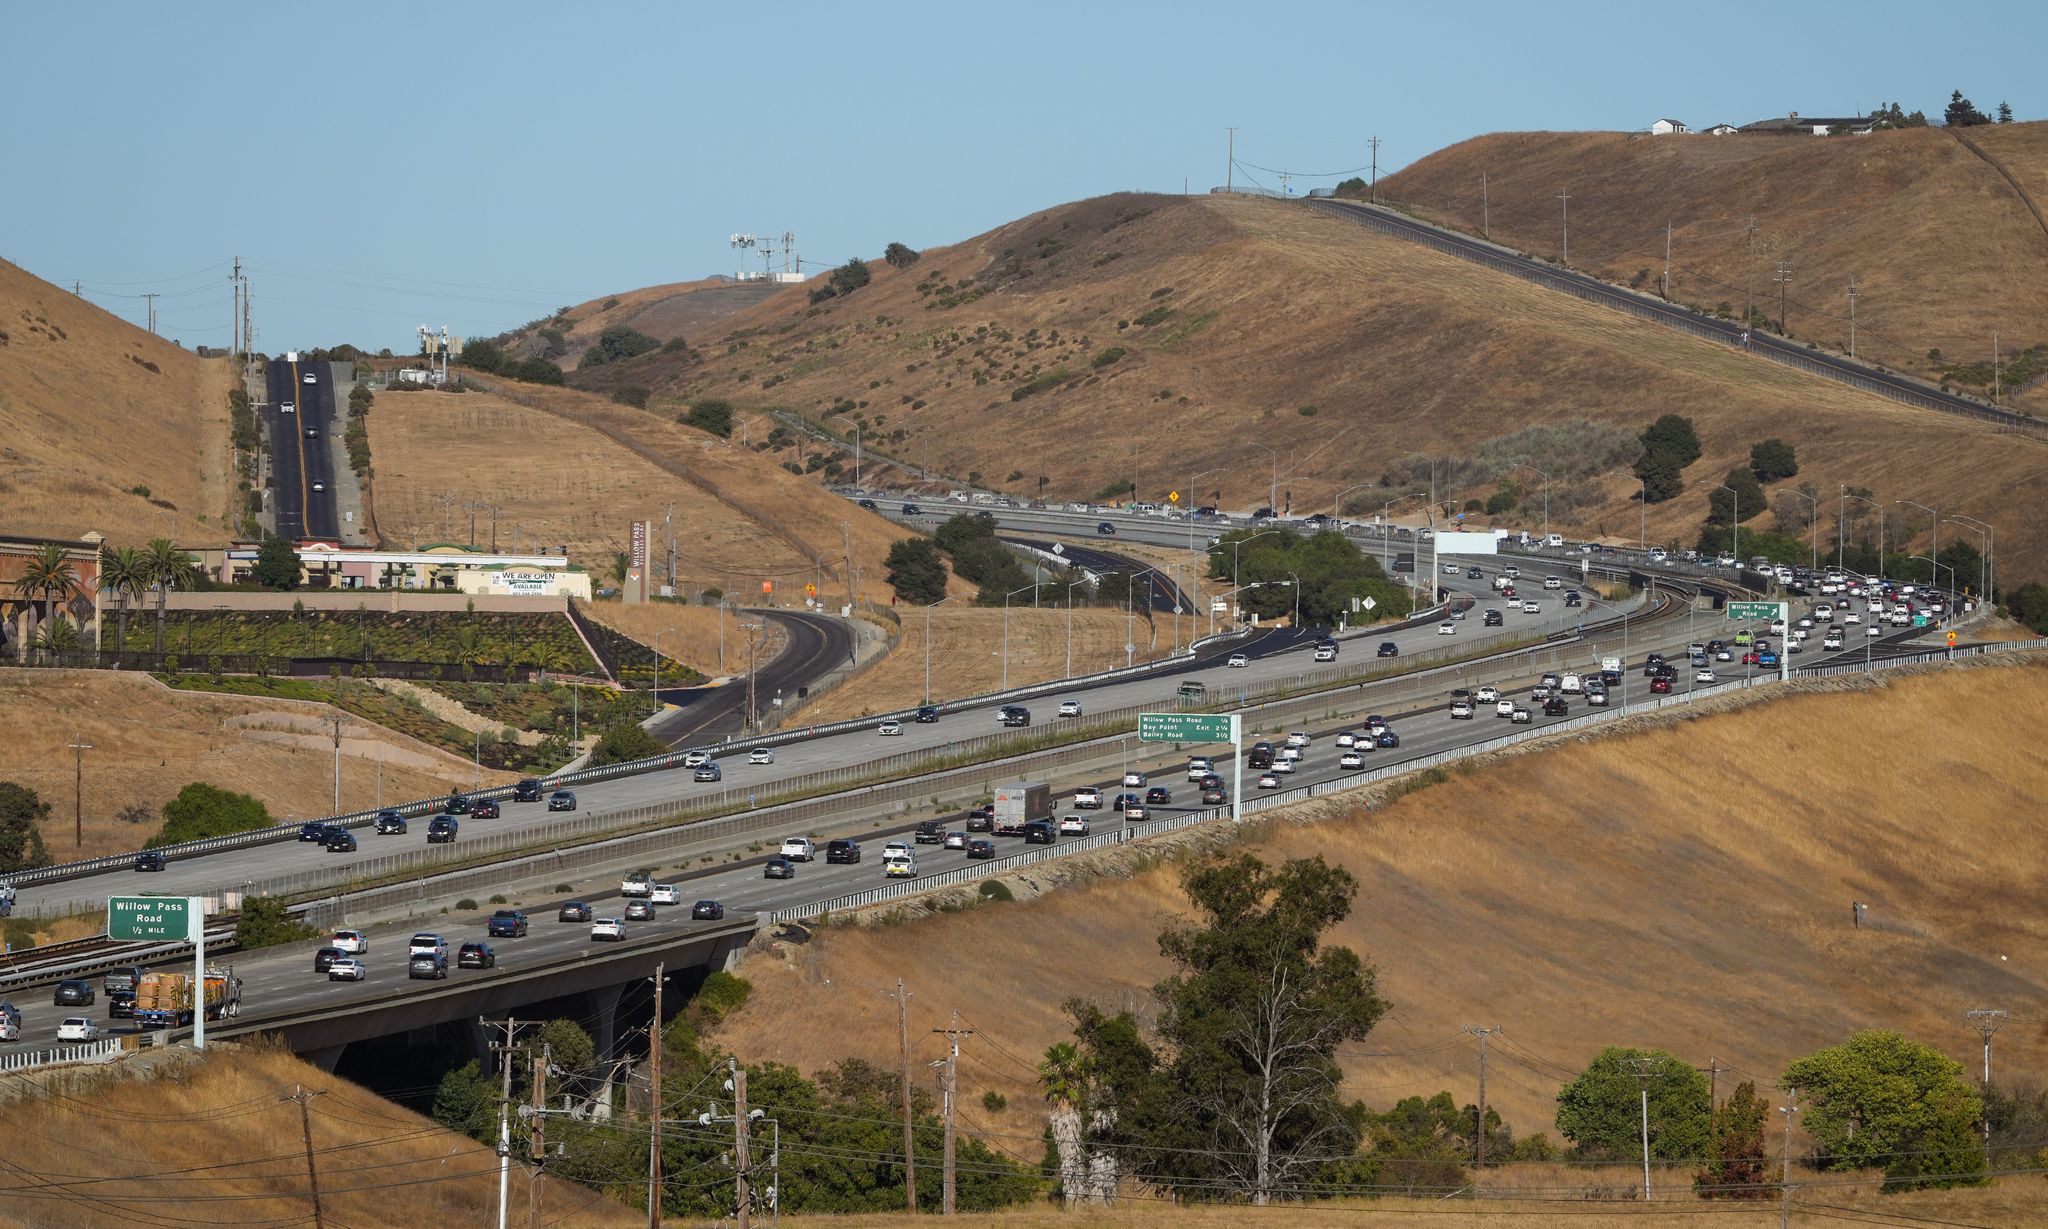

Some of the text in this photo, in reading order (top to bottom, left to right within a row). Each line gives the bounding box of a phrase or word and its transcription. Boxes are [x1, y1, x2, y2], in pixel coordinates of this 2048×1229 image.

[116, 902, 183, 911] Willow Pass
[136, 914, 162, 922] Road
